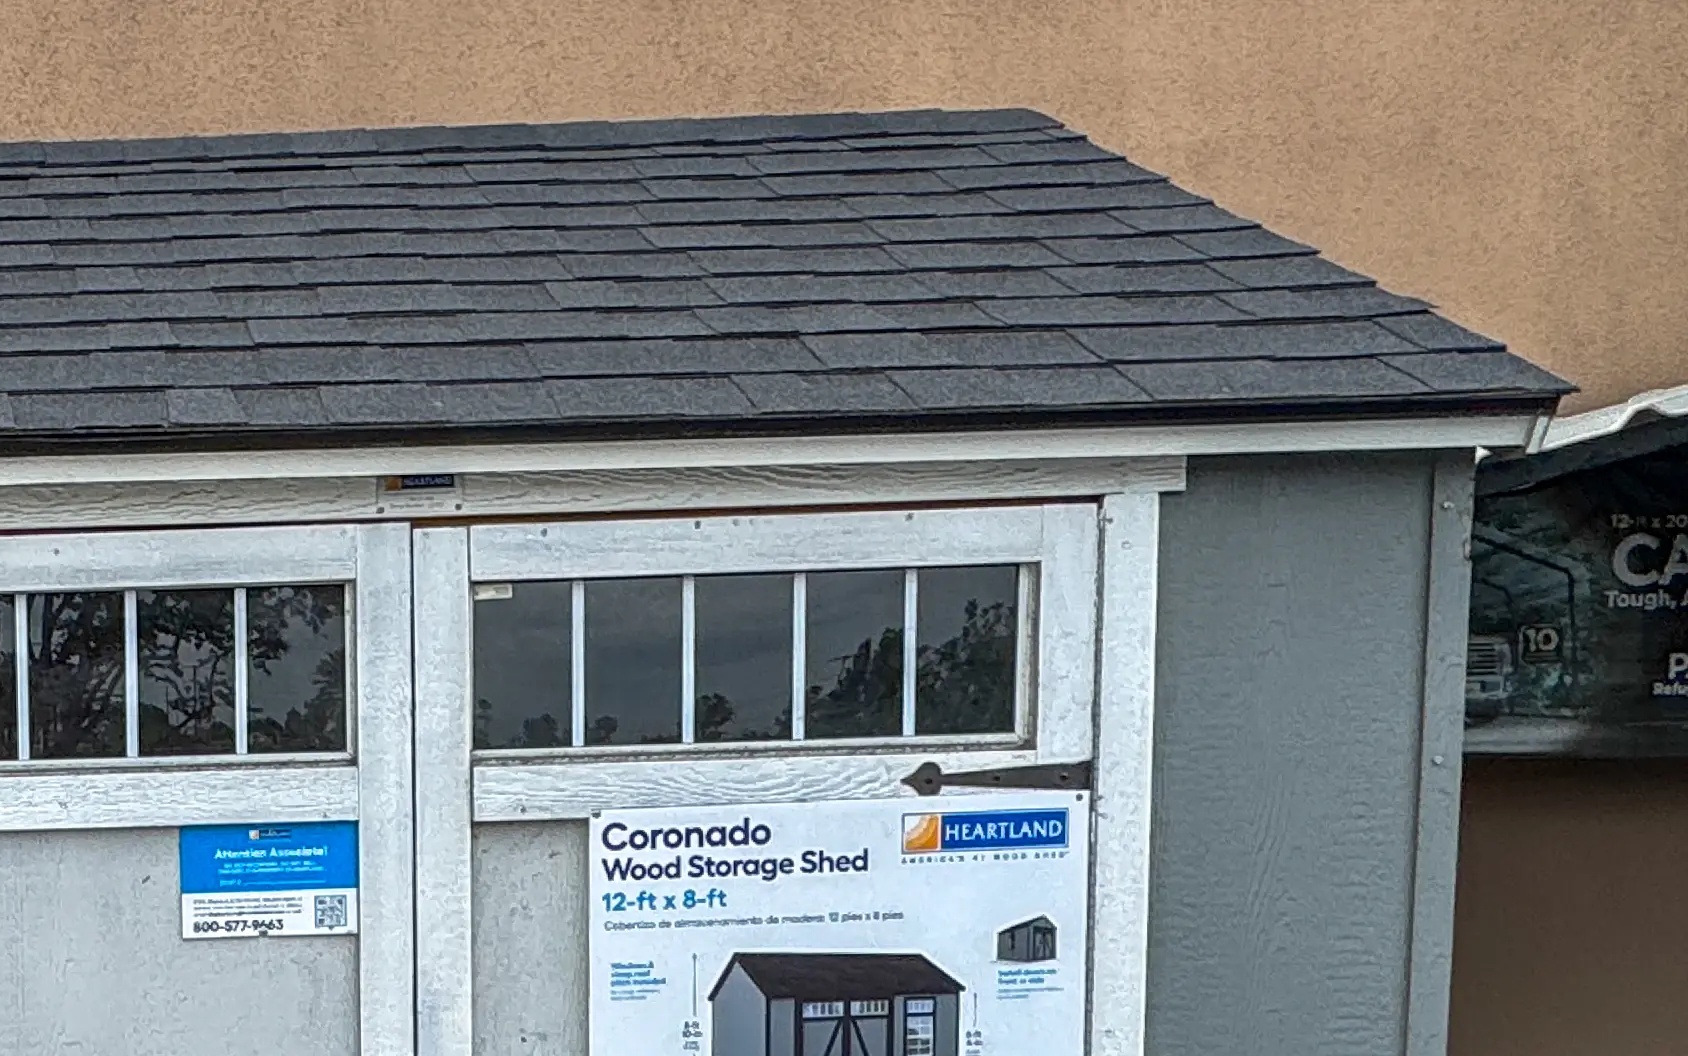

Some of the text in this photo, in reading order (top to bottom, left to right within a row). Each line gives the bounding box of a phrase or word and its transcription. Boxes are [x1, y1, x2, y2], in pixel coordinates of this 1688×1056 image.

[1604, 588, 1677, 610] Tough,
[1525, 628, 1559, 652] 10
[602, 817, 772, 851] Coronado
[944, 819, 1063, 841] HEARTLAND
[601, 848, 869, 881] Wood Storage Shed
[601, 888, 727, 911] 12-ft x 8-ft
